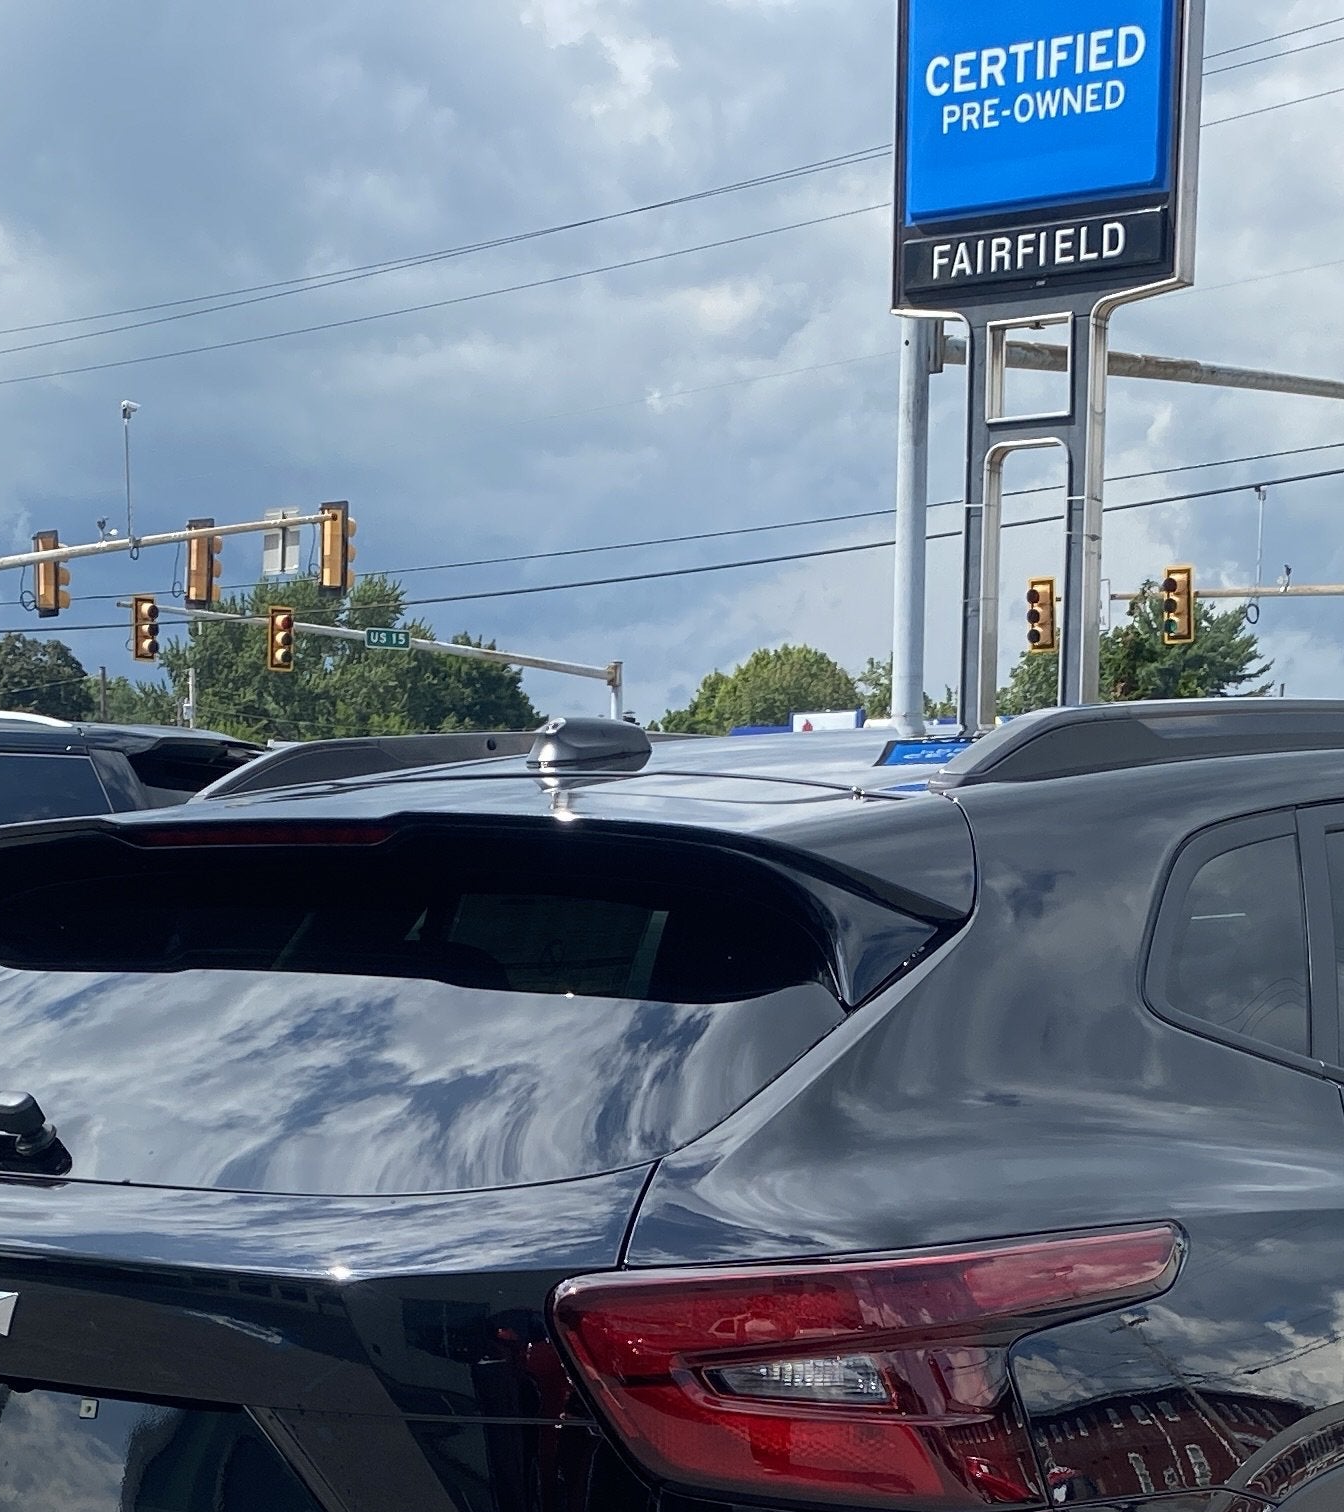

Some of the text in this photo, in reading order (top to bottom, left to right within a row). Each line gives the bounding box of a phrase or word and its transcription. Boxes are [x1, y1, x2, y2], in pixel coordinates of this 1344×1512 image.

[925, 25, 1146, 97] CERTIFIED
[942, 79, 1125, 134] PRE-OWNED
[932, 222, 1126, 280] FAIRFIELD
[370, 631, 406, 645] US 15
